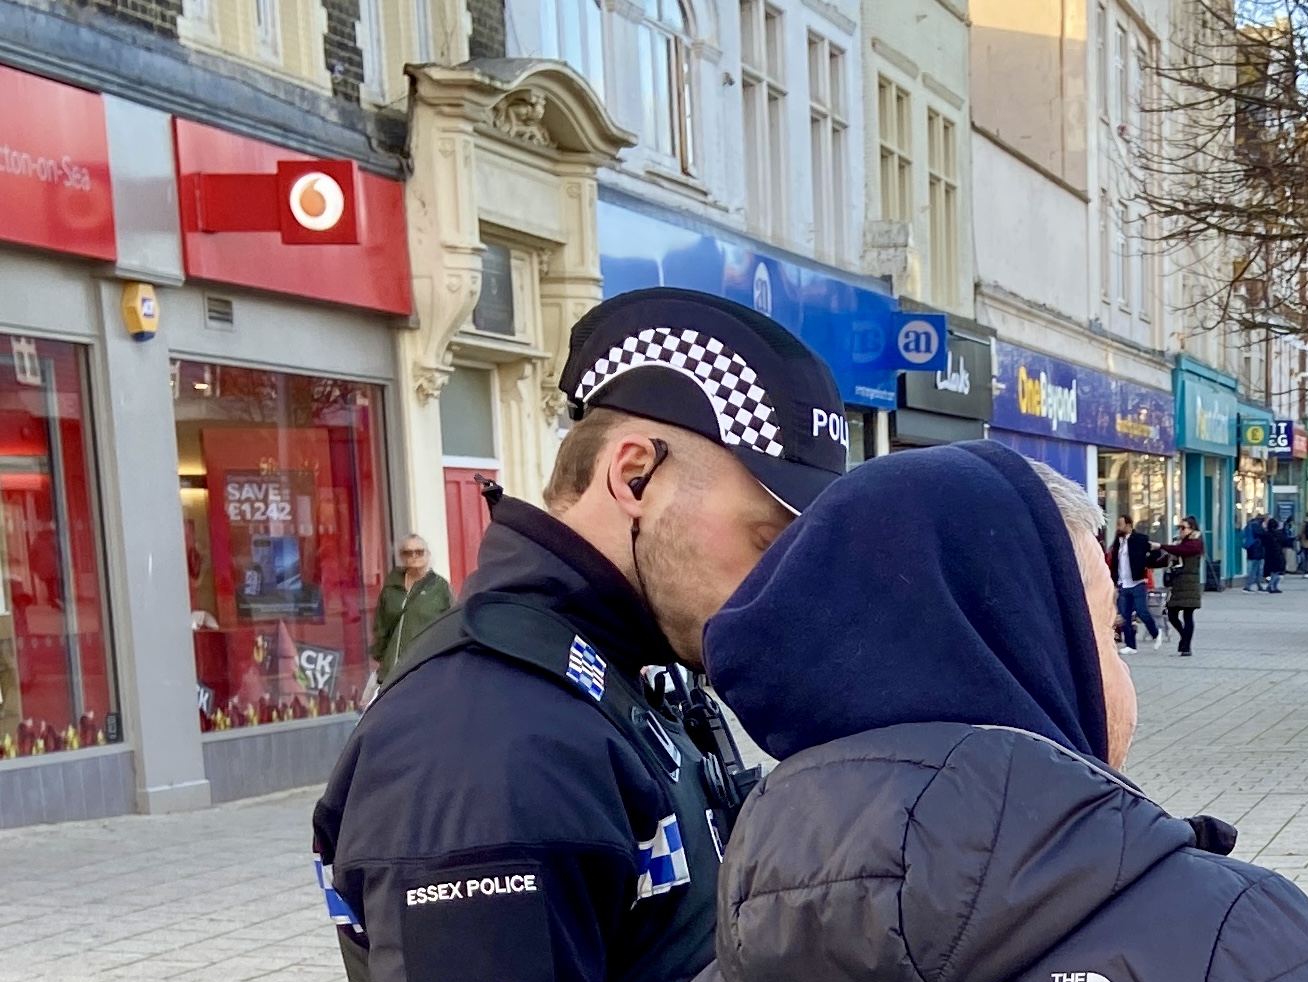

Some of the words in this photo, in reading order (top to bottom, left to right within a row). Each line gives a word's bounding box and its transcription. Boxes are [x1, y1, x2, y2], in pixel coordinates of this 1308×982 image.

[227, 483, 281, 501] SAVE
[228, 502, 292, 521] £1242
[406, 881, 463, 906] ESSEX
[466, 874, 537, 898] POLICE
